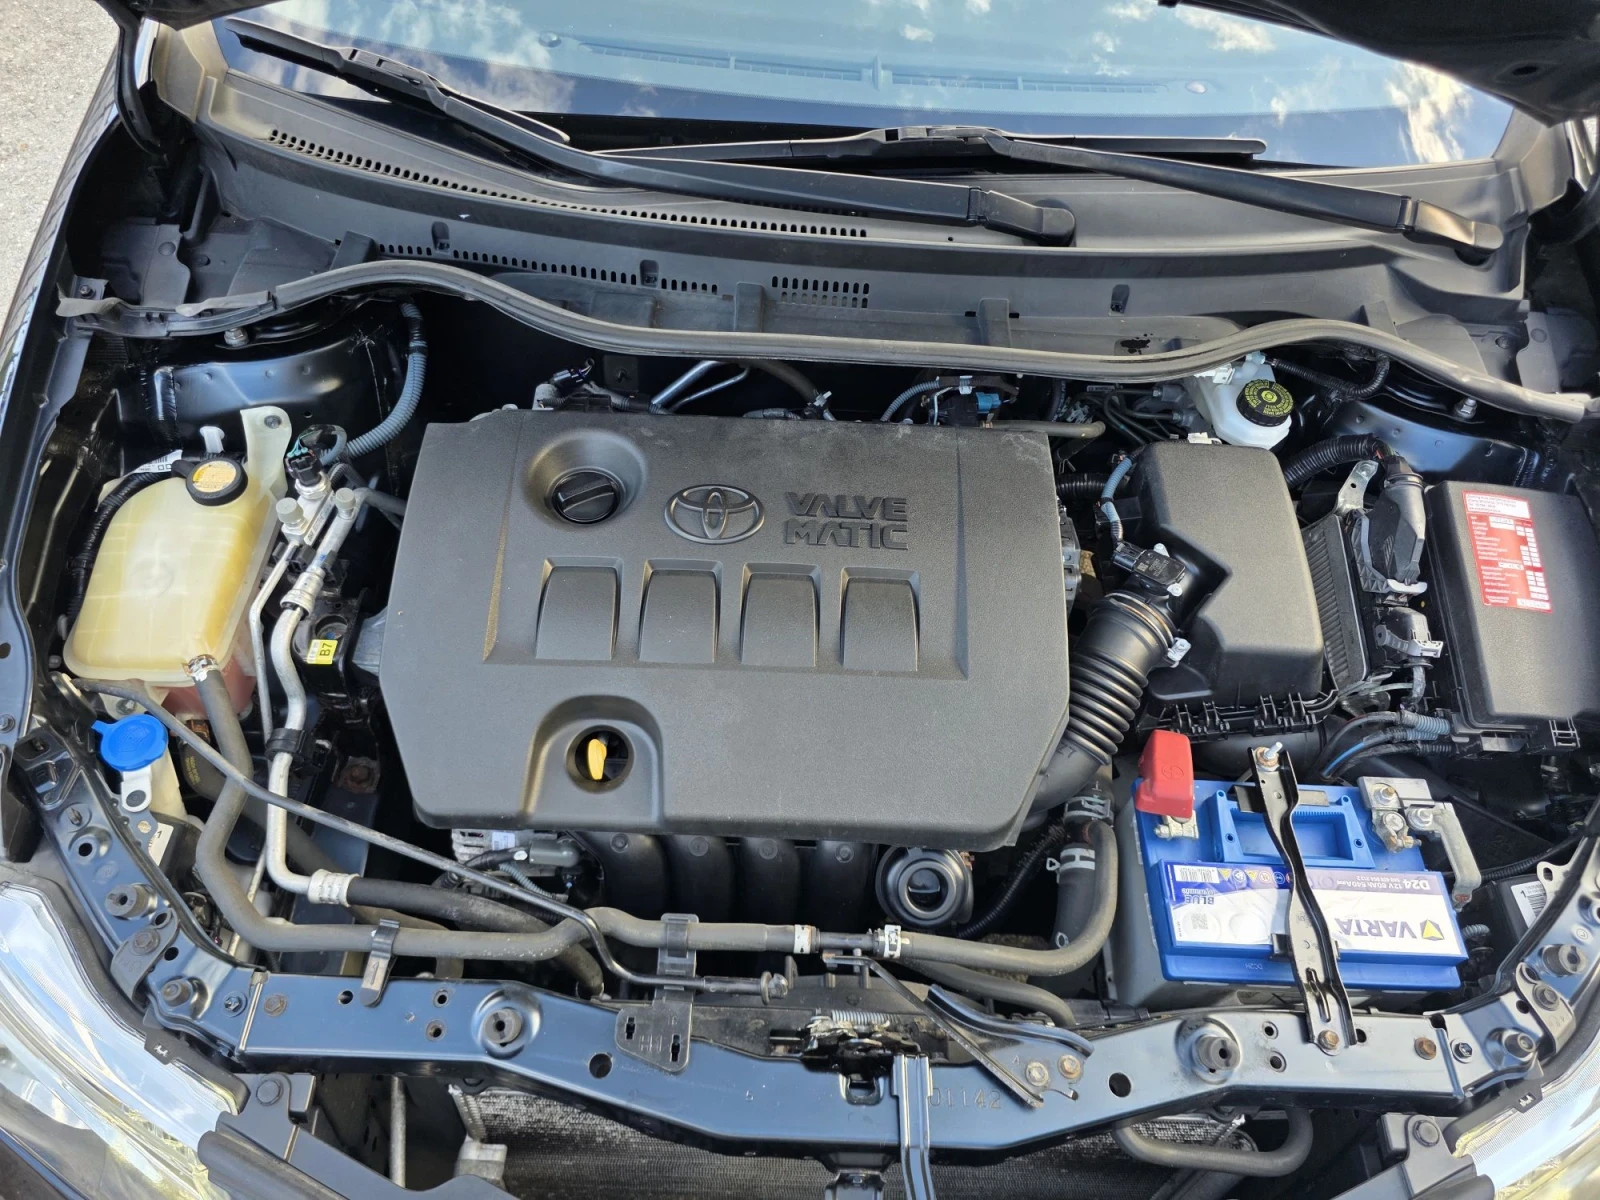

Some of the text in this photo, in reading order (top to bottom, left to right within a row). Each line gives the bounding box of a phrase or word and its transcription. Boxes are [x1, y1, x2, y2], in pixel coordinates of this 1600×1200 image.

[784, 492, 908, 522] VALVE
[785, 519, 908, 550] MATIC
[320, 643, 332, 656] B7
[1403, 879, 1430, 890] D24
[1185, 896, 1214, 905] BLUE
[1334, 918, 1417, 938] VARTA
